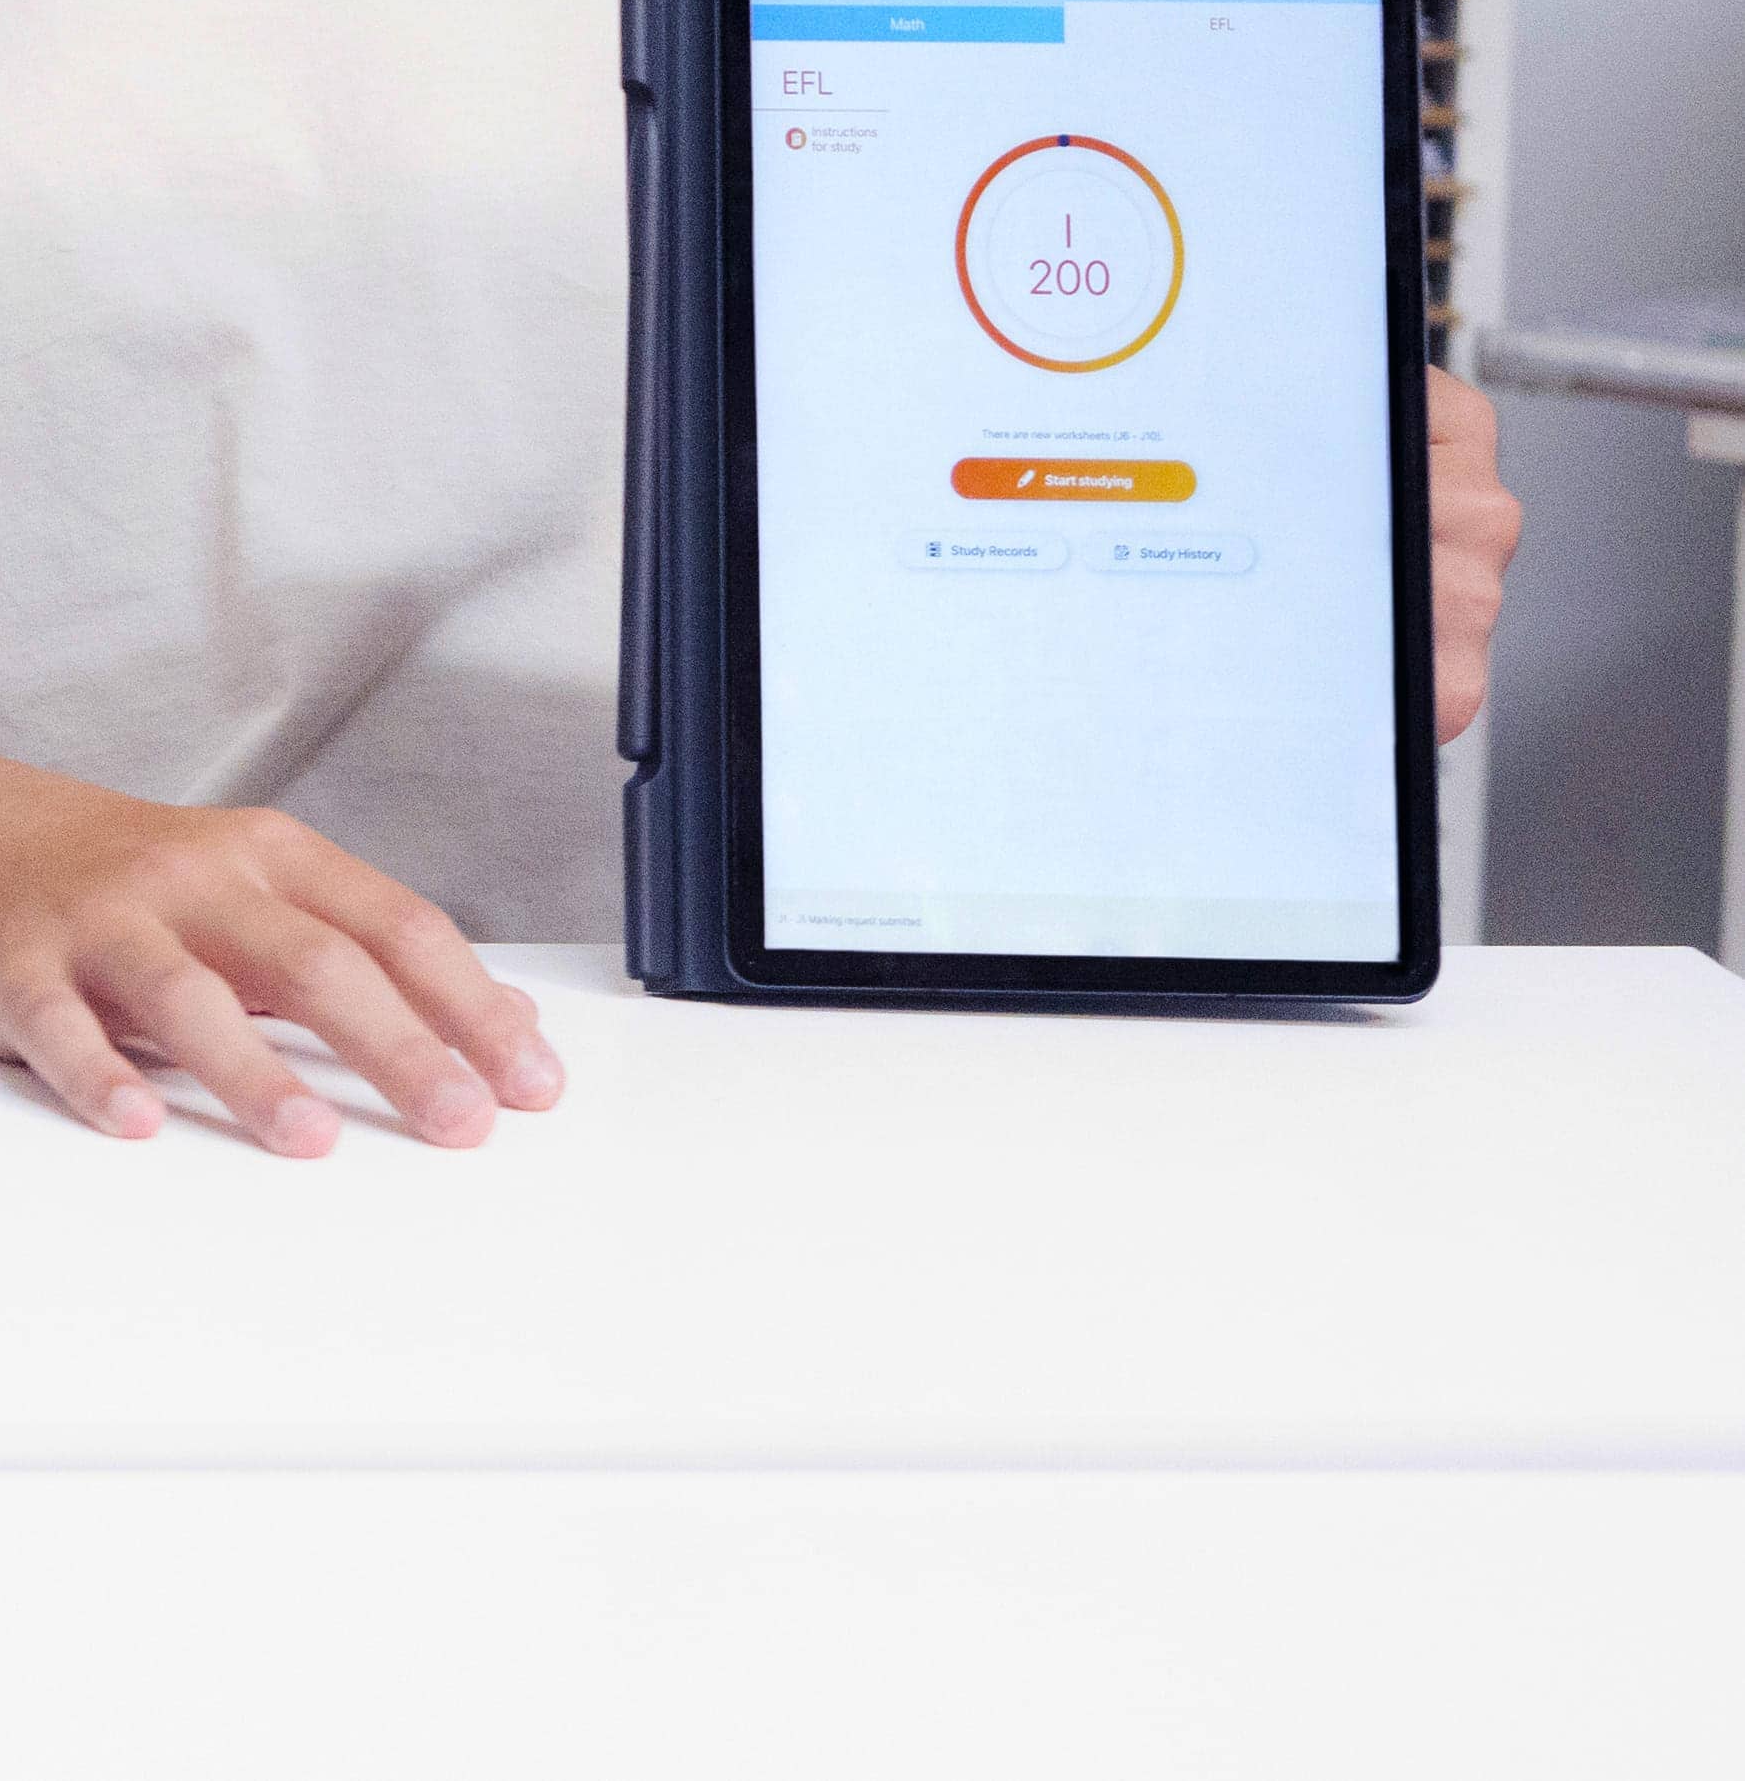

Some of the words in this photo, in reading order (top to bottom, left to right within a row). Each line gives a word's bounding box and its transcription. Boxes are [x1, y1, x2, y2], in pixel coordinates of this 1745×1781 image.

[890, 17, 926, 31] Math
[1209, 17, 1235, 31] EFL
[783, 70, 834, 95] EFL
[811, 126, 878, 138] Instructions
[811, 141, 828, 153] for
[830, 141, 862, 154] study
[1030, 259, 1110, 296] 200
[982, 428, 1010, 440] There
[1012, 431, 1029, 440] are
[1031, 431, 1051, 440] new
[1054, 430, 1111, 441] worksheets
[1044, 474, 1077, 488] Start
[1079, 474, 1134, 491] studying
[950, 544, 985, 559] Study
[989, 545, 1038, 558] Records
[1140, 547, 1175, 561] Study
[1178, 548, 1222, 562] History
